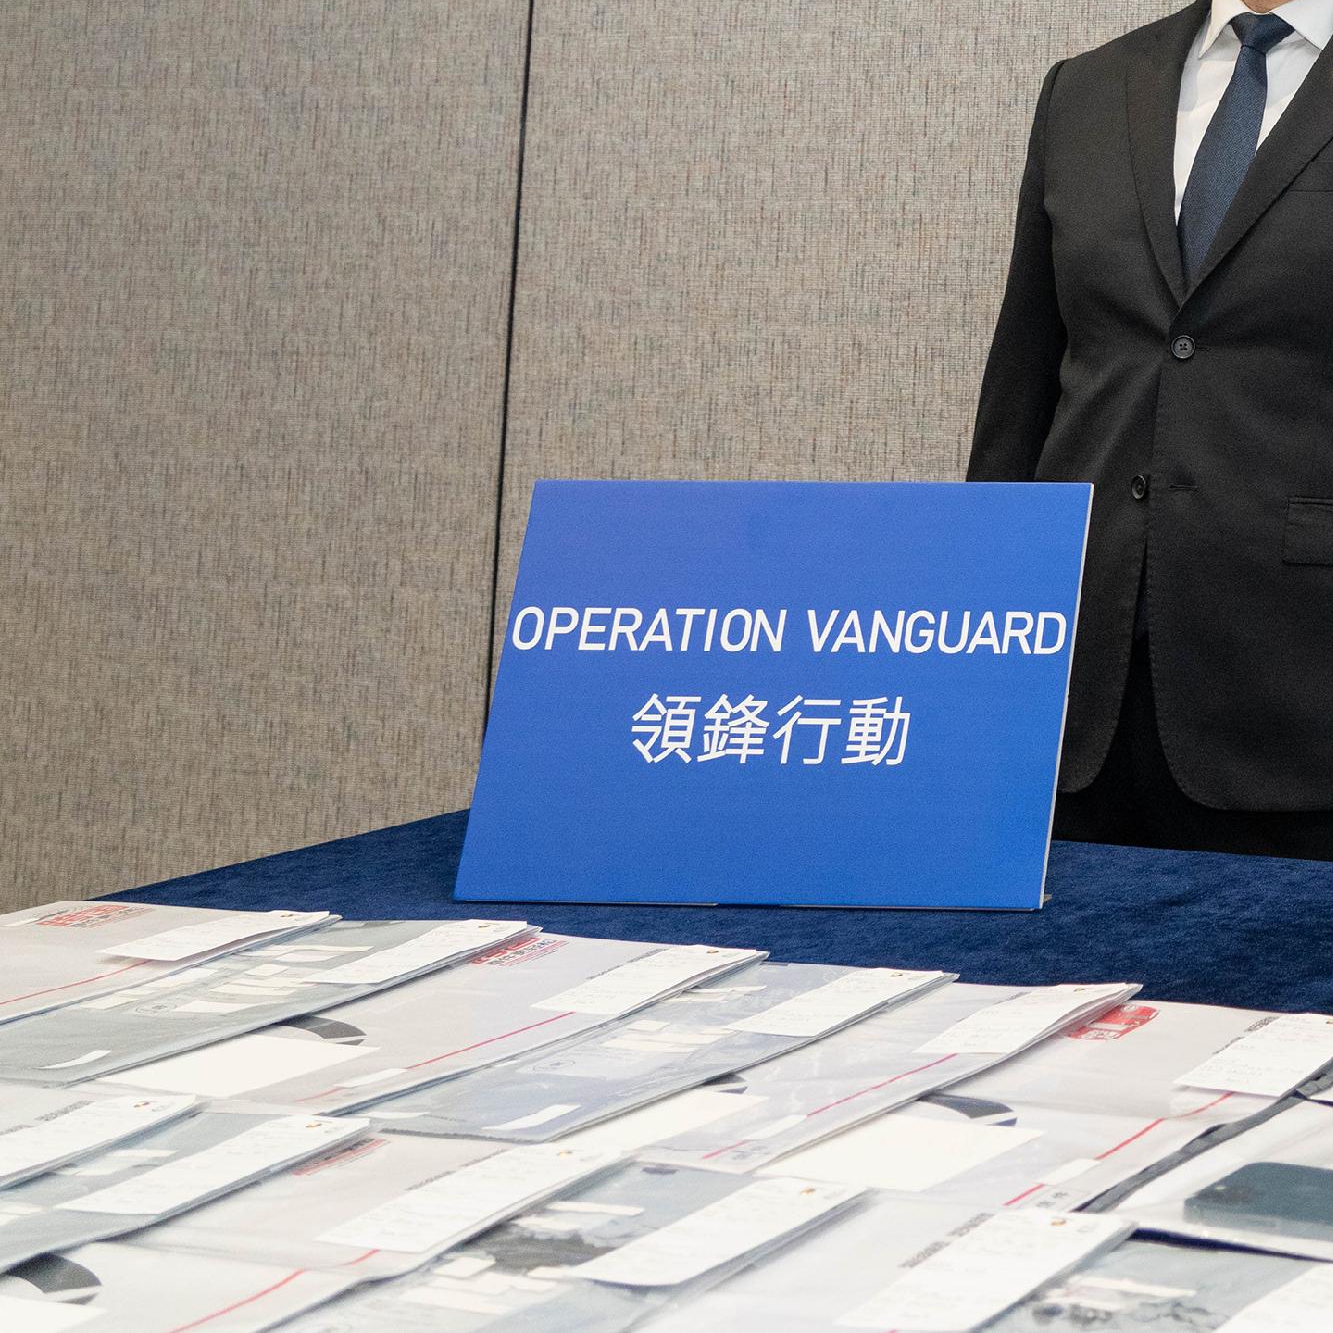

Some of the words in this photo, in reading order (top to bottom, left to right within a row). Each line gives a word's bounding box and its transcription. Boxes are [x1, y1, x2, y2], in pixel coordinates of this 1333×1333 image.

[512, 606, 787, 652] OPERATION
[807, 609, 1067, 655] VANGUARD
[630, 693, 911, 766] 領鋒行動
